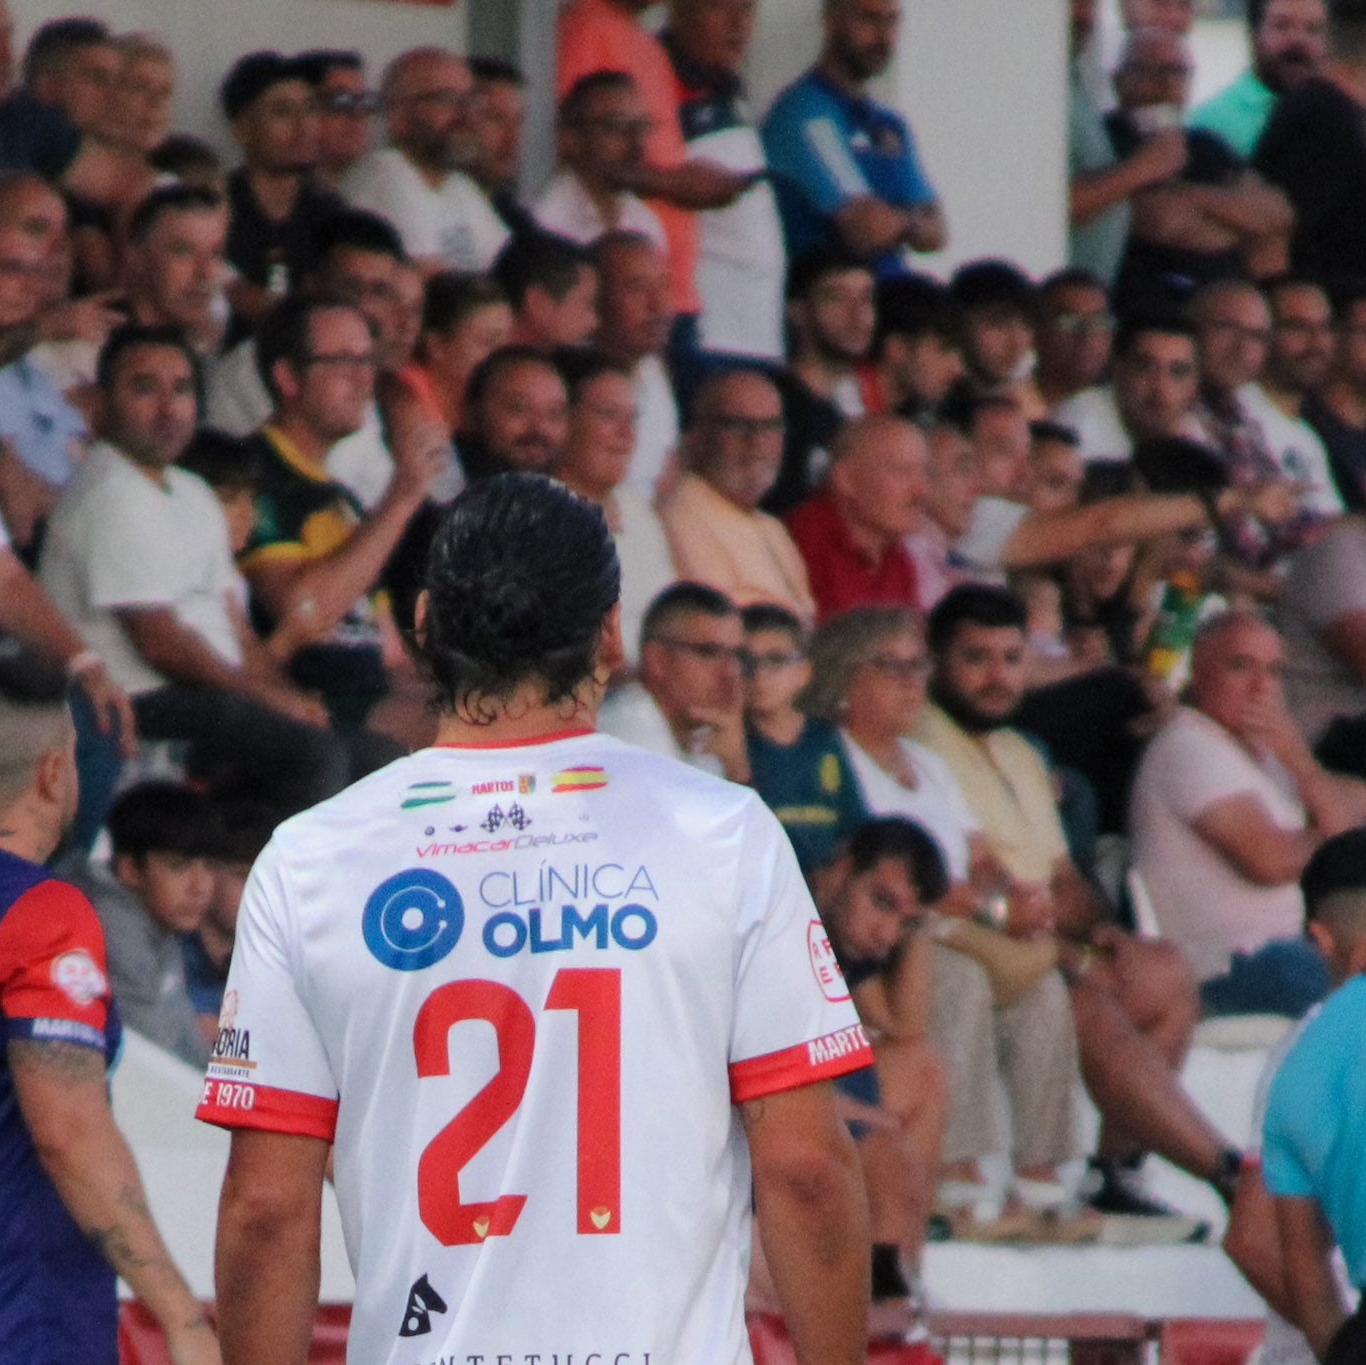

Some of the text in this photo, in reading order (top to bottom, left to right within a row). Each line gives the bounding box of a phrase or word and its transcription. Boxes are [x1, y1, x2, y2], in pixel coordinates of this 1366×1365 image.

[479, 859, 660, 908] CLÍNICA
[482, 903, 658, 958] OLMO
[216, 1083, 256, 1111] 1970
[413, 967, 622, 1248] 21
